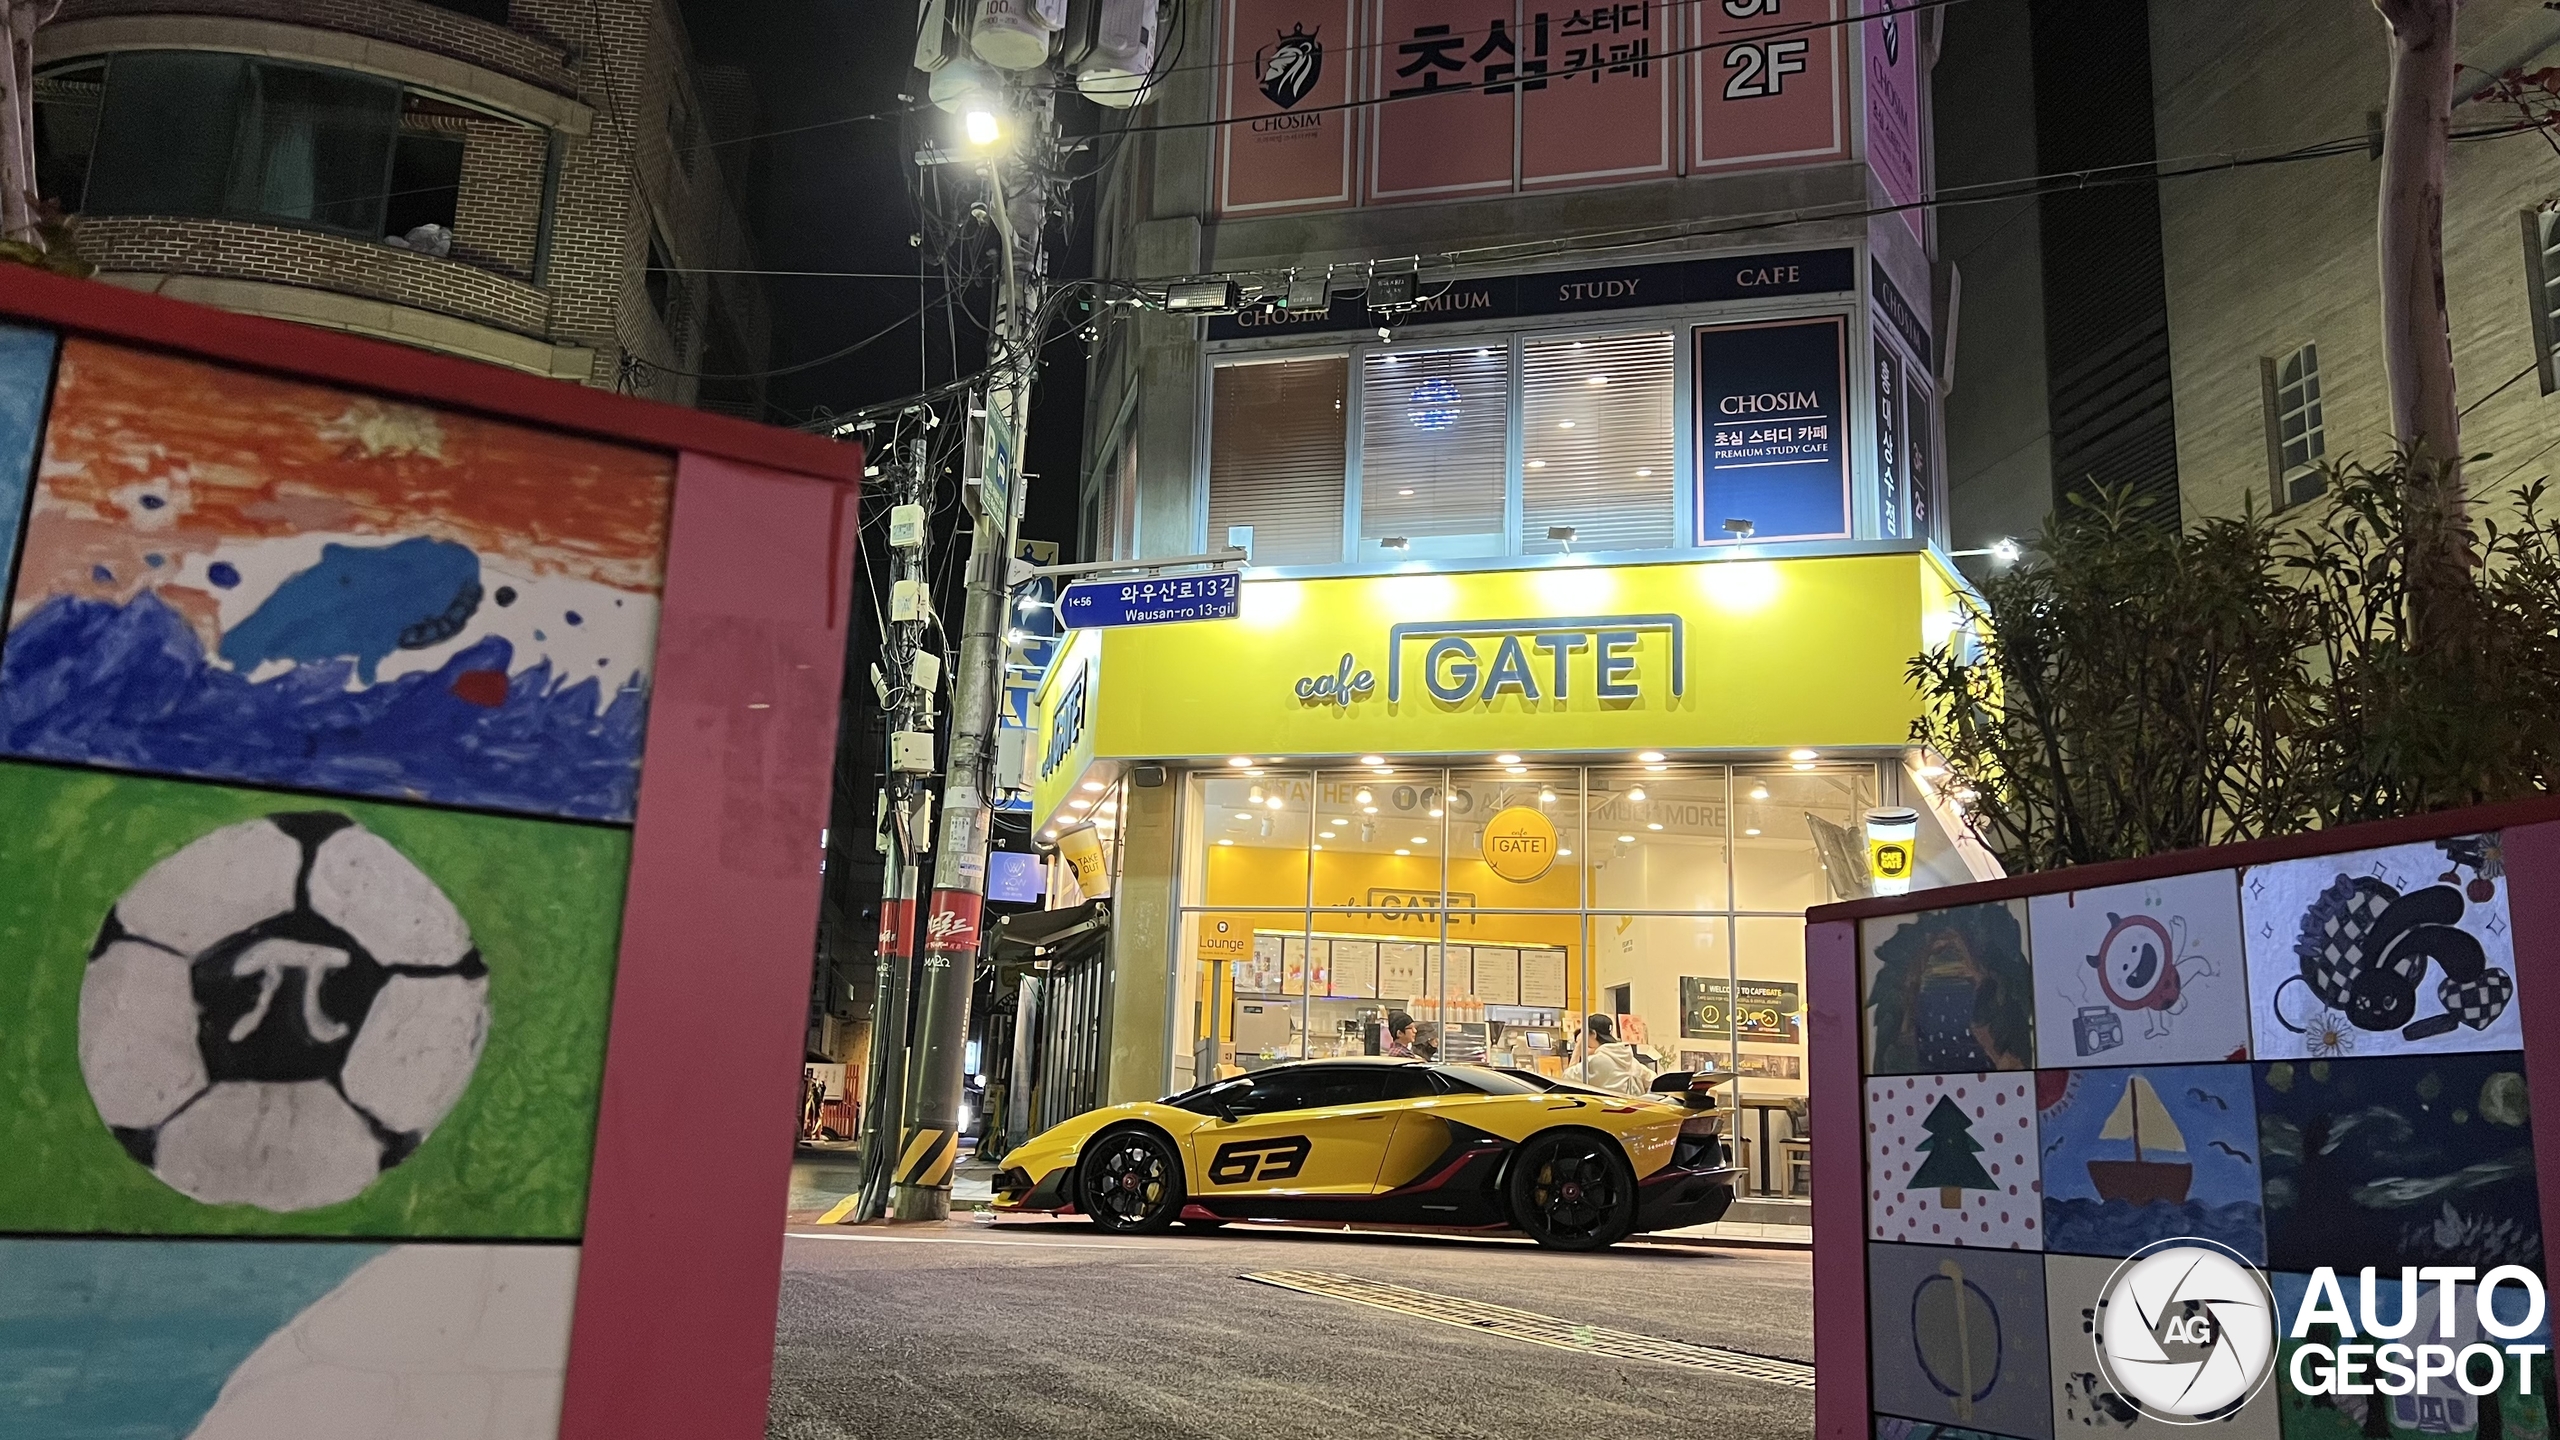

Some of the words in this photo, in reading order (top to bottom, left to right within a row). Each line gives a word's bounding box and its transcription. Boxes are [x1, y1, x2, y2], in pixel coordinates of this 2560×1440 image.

[1560, 1, 1649, 37] 스터디
[1390, 13, 1549, 98] 초심
[1563, 38, 1649, 85] 카페
[1723, 38, 1809, 101] 2F
[1252, 113, 1321, 133] CHOSIM
[1559, 279, 1641, 301] STUDY
[1736, 265, 1800, 288] CAFE
[1882, 282, 1922, 352] CHOSIM
[1720, 390, 1819, 415] CHOSIM
[985, 424, 997, 470] P
[1714, 430, 1743, 447] 초심
[1748, 427, 1792, 444] 스터디
[1798, 425, 1828, 442] 카페
[1715, 448, 1764, 459] PREMIUM
[1765, 445, 1801, 456] STUDY
[1802, 443, 1829, 453] CAFE
[1120, 576, 1236, 605] 와우산로13길
[1125, 606, 1195, 622] Wausan-ro
[1198, 602, 1236, 618] 13-gil
[1294, 652, 1376, 708] cafe
[1424, 630, 1641, 702] GATE
[1665, 804, 1727, 827] MORE
[1500, 839, 1540, 853] GATE
[1880, 851, 1902, 861] CAFE
[1077, 852, 1099, 867] TAKE
[1082, 862, 1099, 875] OUT
[1880, 860, 1902, 869] GATE
[1381, 895, 1460, 924] GATE
[1199, 935, 1245, 953] Lounge
[1709, 985, 1741, 996] WELCOE
[1751, 987, 1783, 997] CAFEGATE
[1208, 1135, 1312, 1185] 63
